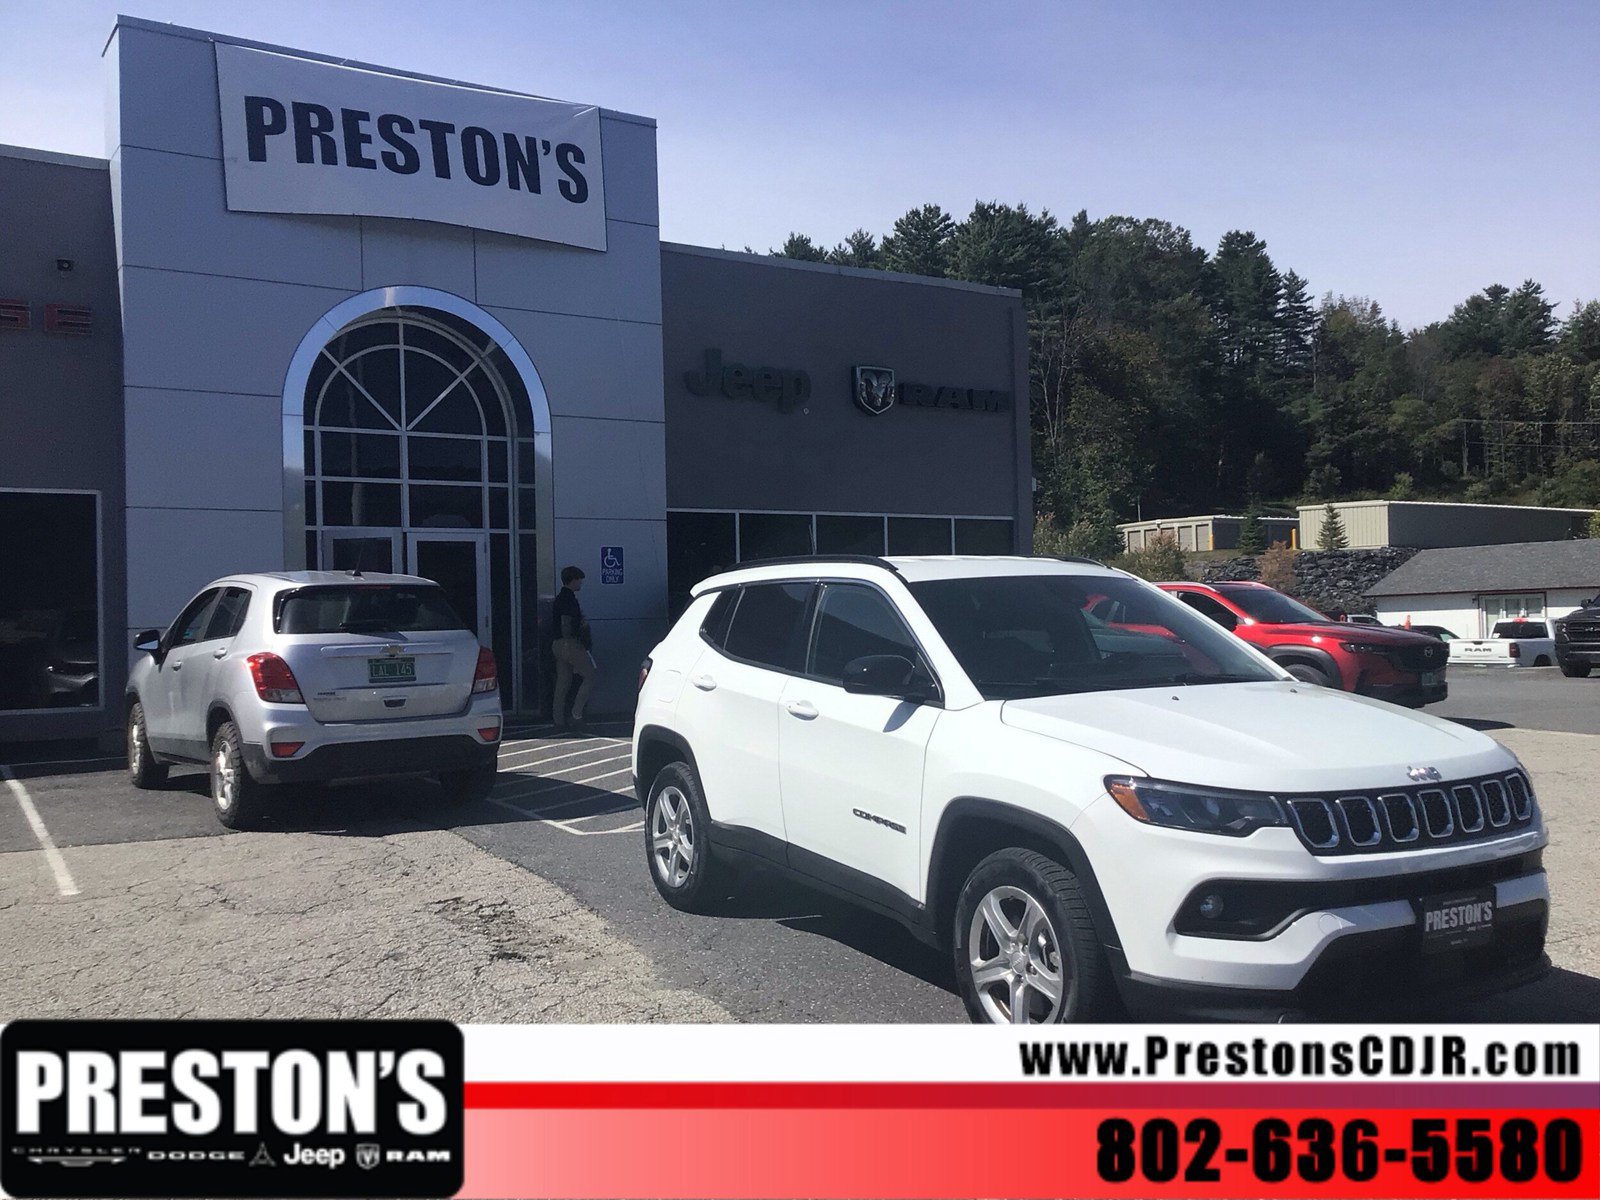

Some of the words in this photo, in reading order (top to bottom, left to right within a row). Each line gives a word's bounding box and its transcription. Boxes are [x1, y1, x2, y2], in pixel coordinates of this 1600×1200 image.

[244, 95, 589, 204] PRESTON'S
[684, 348, 811, 414] Jeep
[900, 383, 1010, 412] RAM
[1425, 901, 1493, 932] PRESTON'S
